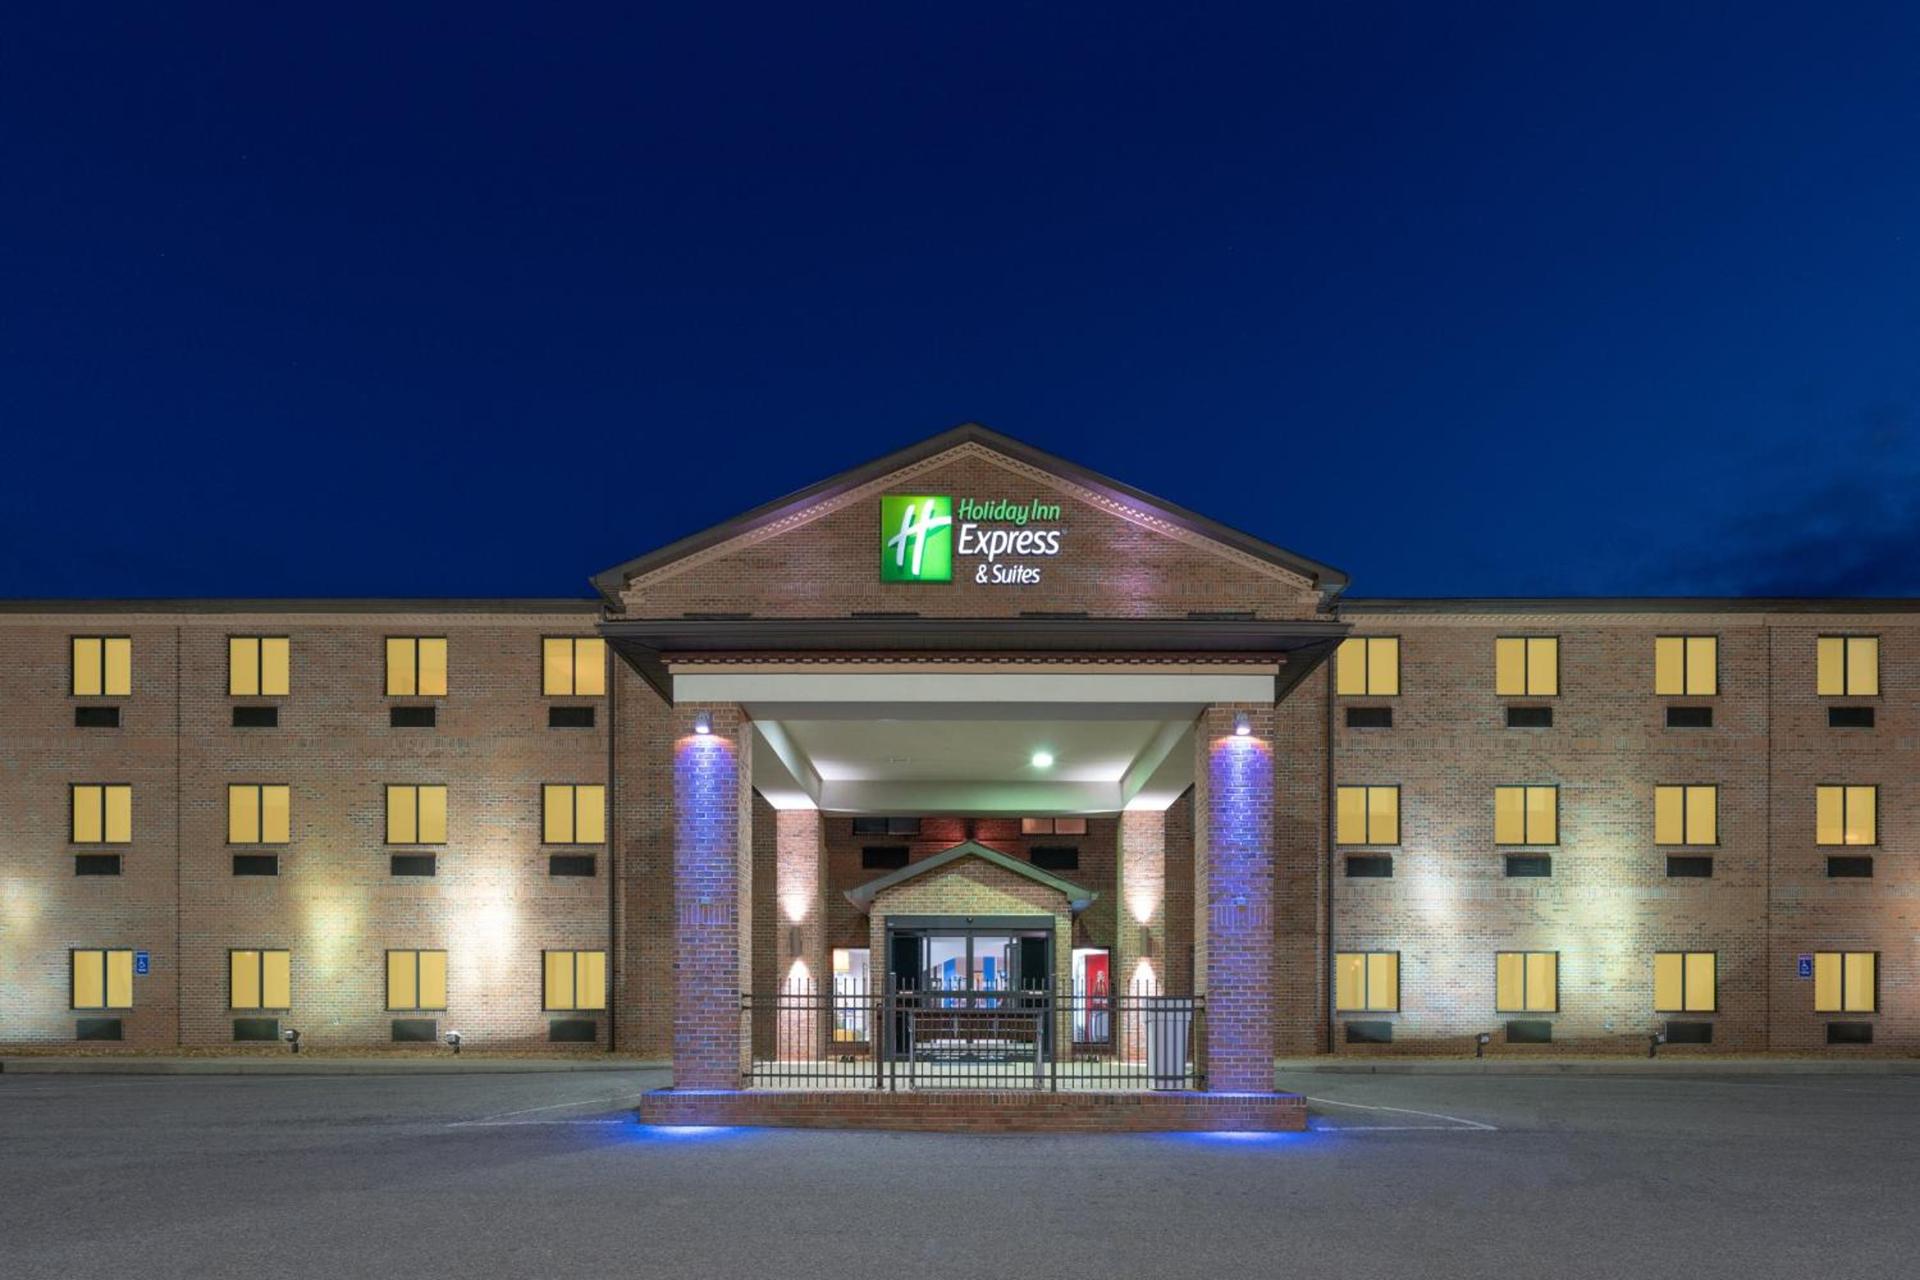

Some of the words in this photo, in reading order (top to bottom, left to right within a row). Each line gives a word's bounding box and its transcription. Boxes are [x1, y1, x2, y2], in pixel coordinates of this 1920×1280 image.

[958, 499, 1027, 525] Holiday
[1031, 499, 1060, 520] Inn
[958, 523, 1060, 562] Express
[975, 564, 988, 584] &
[992, 564, 1040, 584] Suites
